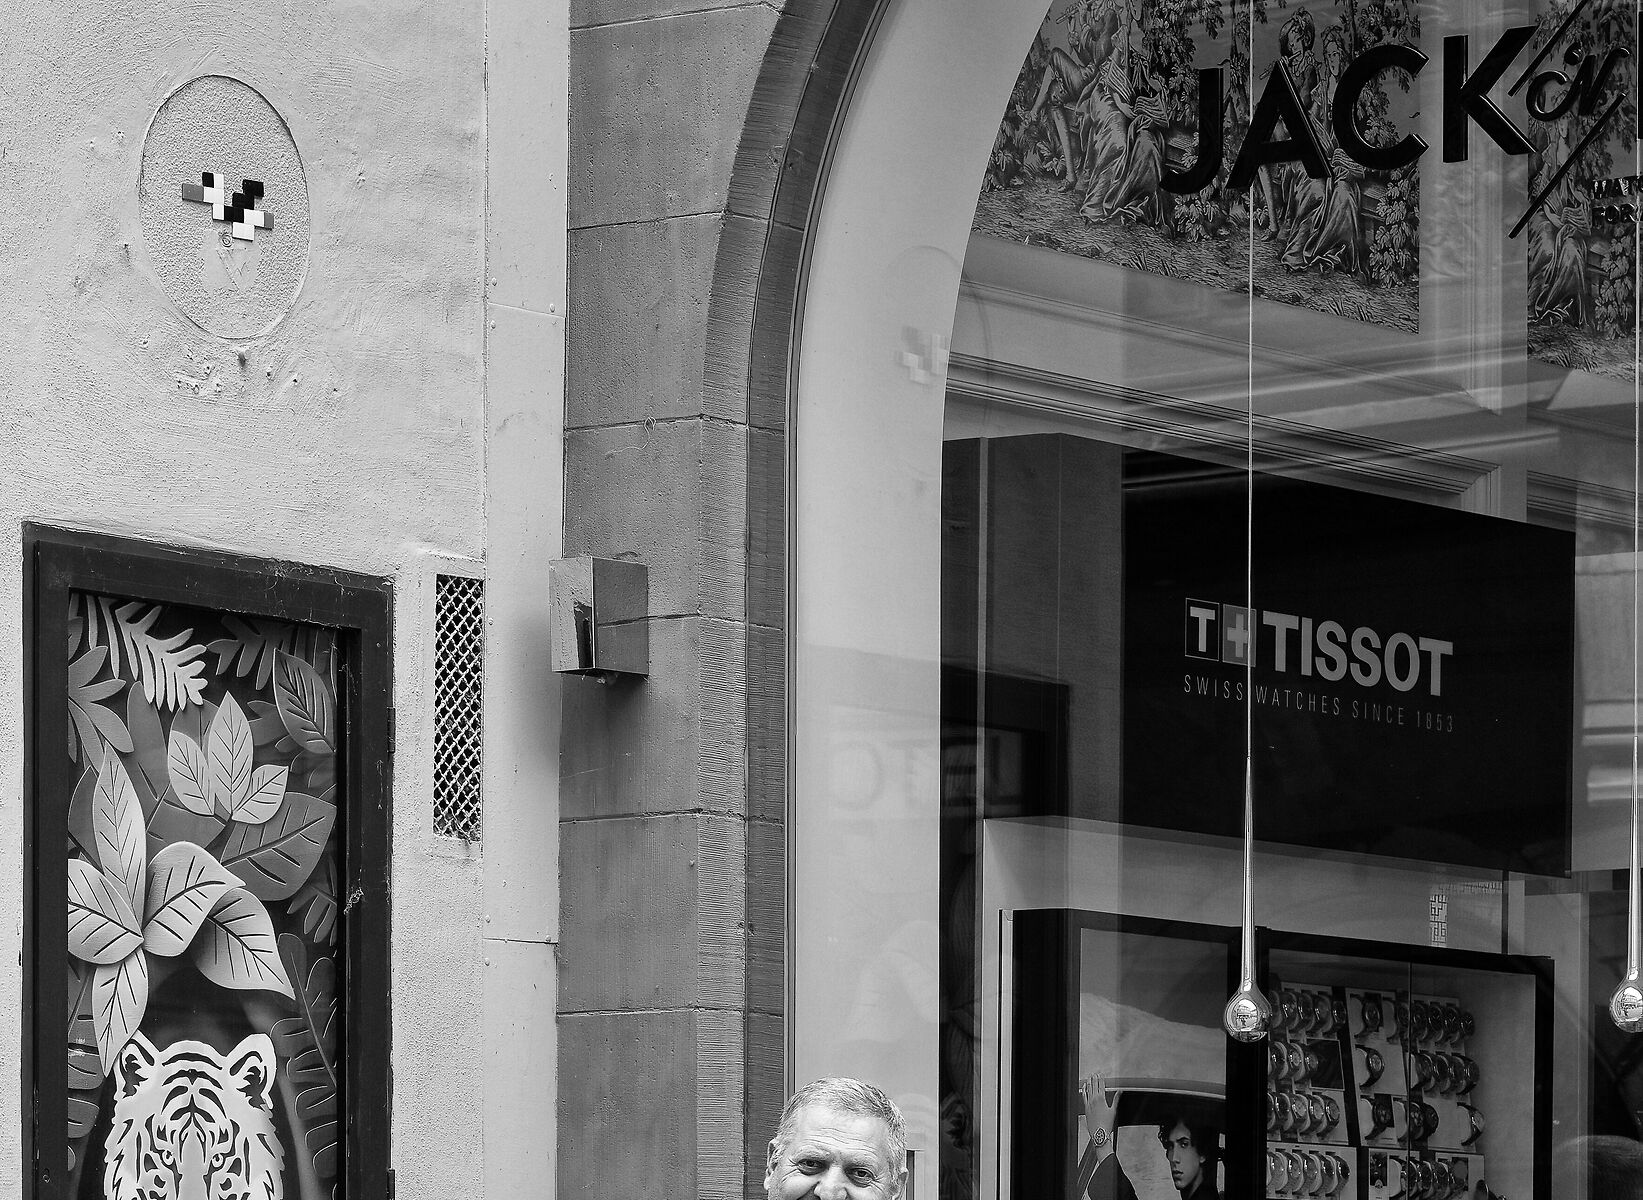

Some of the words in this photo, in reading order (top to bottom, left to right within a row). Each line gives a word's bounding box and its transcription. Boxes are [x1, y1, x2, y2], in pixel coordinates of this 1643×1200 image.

[1158, 24, 1540, 195] JACK
[1262, 609, 1454, 697] TISSOT
[1183, 673, 1244, 701] SWISS
[1255, 684, 1341, 716] WATCHES
[1351, 699, 1405, 726] SINCE
[1416, 710, 1454, 733] 1853
